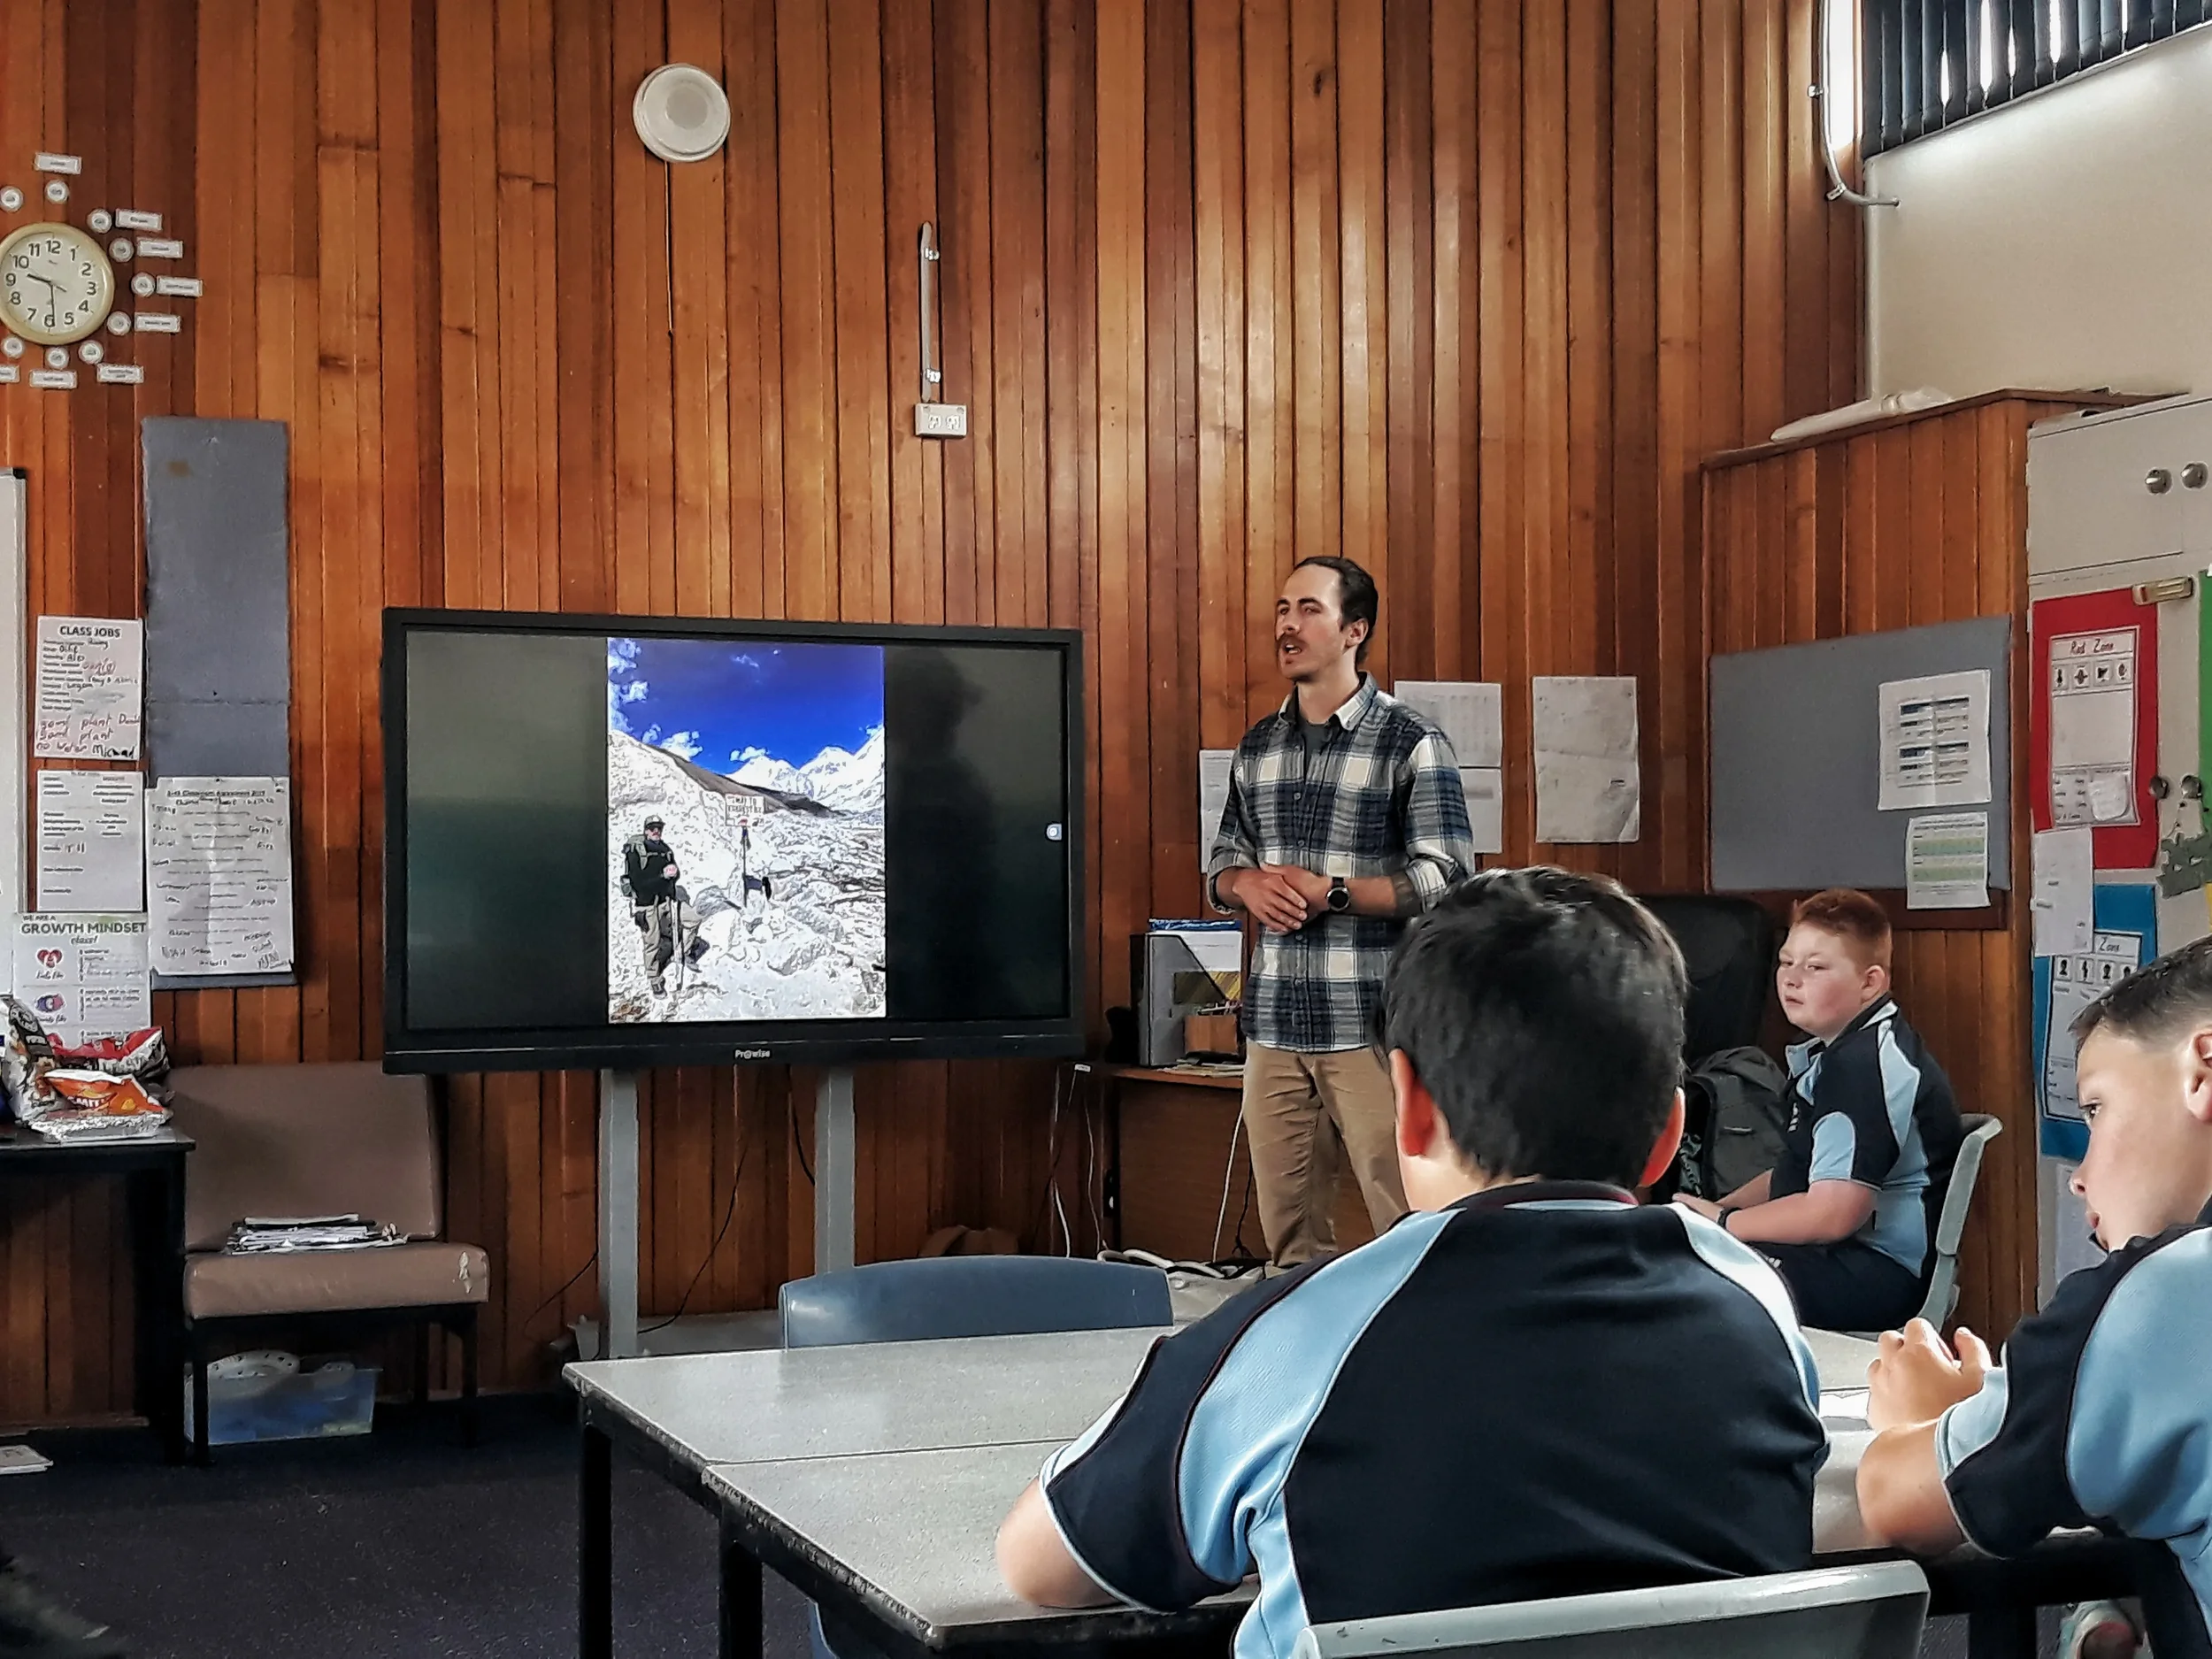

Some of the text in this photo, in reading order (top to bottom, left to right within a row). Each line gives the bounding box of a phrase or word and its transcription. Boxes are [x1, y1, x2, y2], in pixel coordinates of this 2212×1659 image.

[28, 242, 41, 257] 11
[46, 240, 61, 255] 12
[13, 255, 30, 269] 10
[71, 248, 76, 262] 1
[81, 262, 91, 276] 2
[5, 273, 16, 287] 9
[87, 281, 97, 296] 3
[11, 291, 21, 305] 8
[78, 299, 89, 312] 4
[27, 307, 37, 320] 7
[64, 311, 74, 326] 5
[44, 314, 56, 328] 6
[60, 626, 121, 638] CLASS JOBS
[22, 922, 147, 934] GROWTH MINDSET
